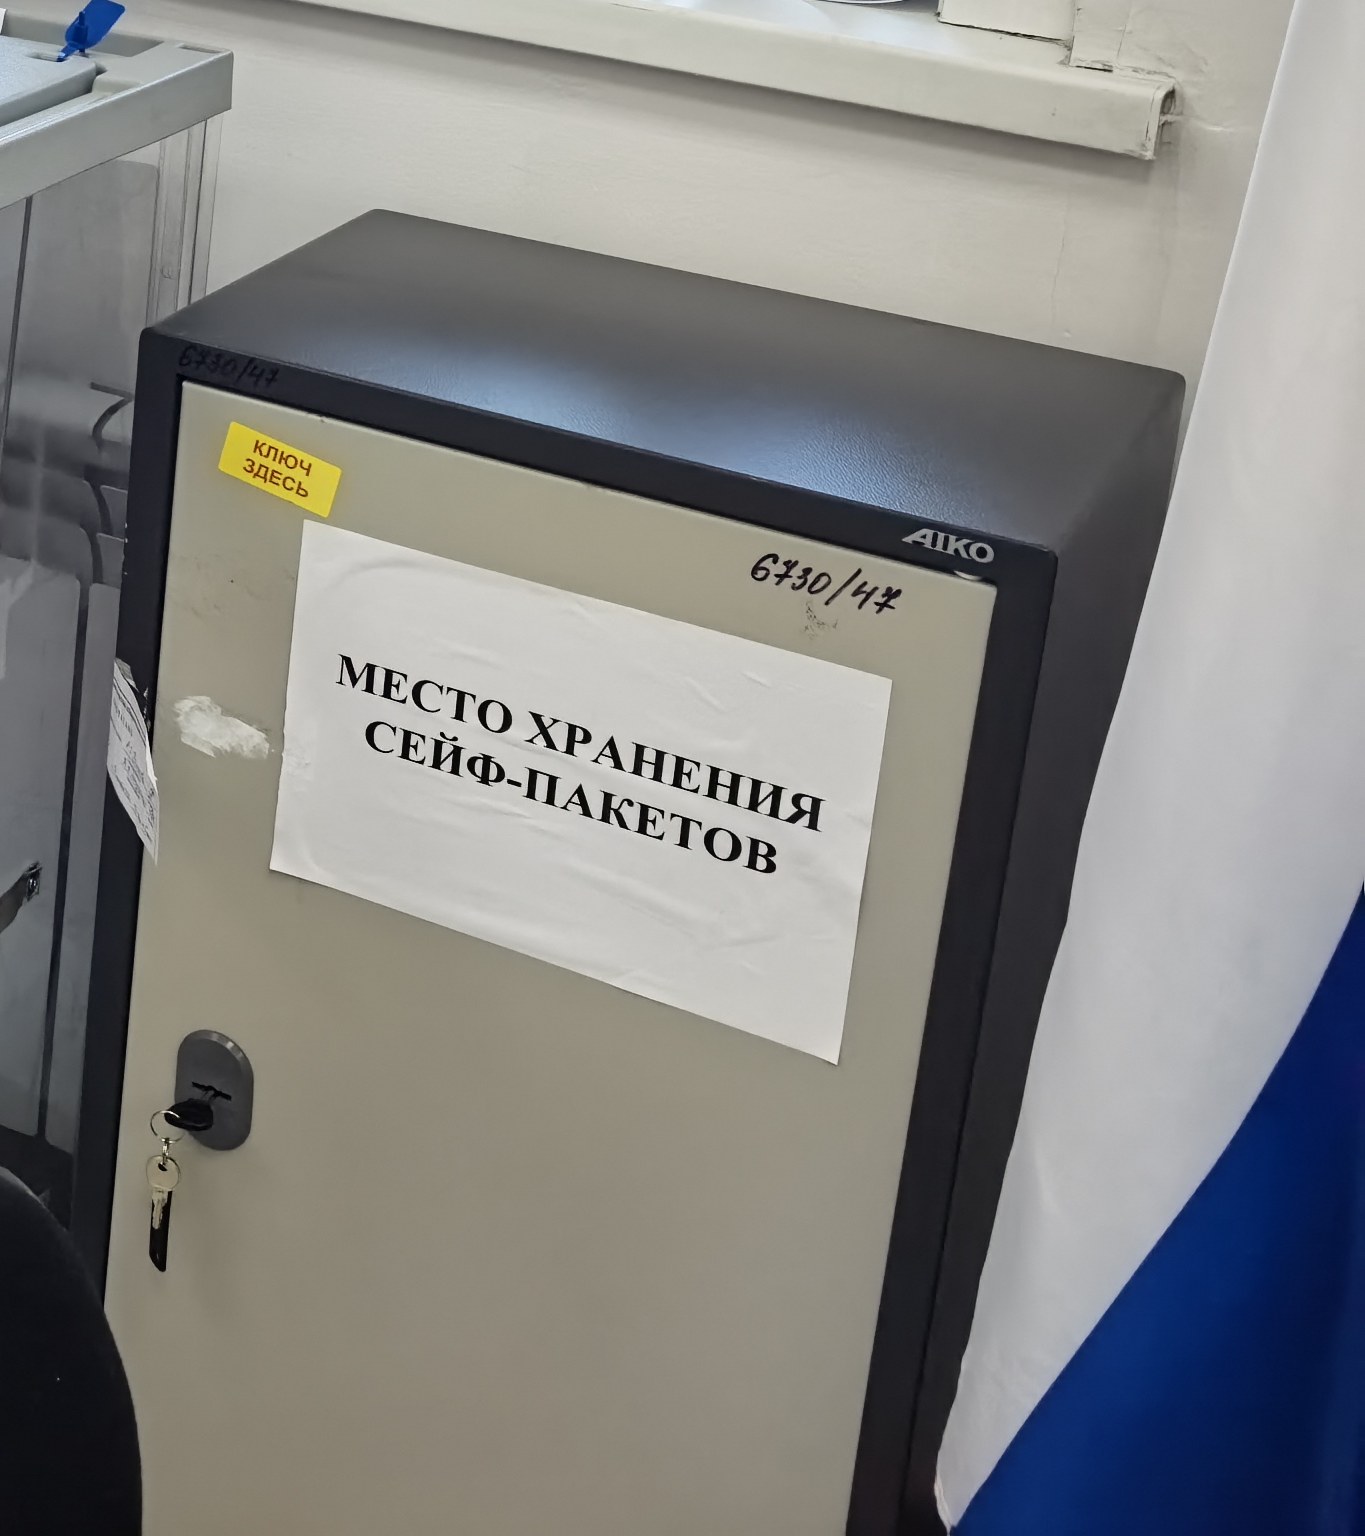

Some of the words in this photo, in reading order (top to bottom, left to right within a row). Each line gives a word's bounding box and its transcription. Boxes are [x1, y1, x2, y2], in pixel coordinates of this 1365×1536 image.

[242, 457, 309, 498] ЗДЕСЬ
[252, 439, 312, 477] КЛЮЧ
[901, 528, 995, 564] AIKO
[750, 553, 903, 615] 6730/47
[335, 654, 513, 735] МЕСТО
[524, 710, 827, 833] ХРАНЕНИЯ
[364, 720, 778, 875] СЕЙФ-ПАКЕТОВ
